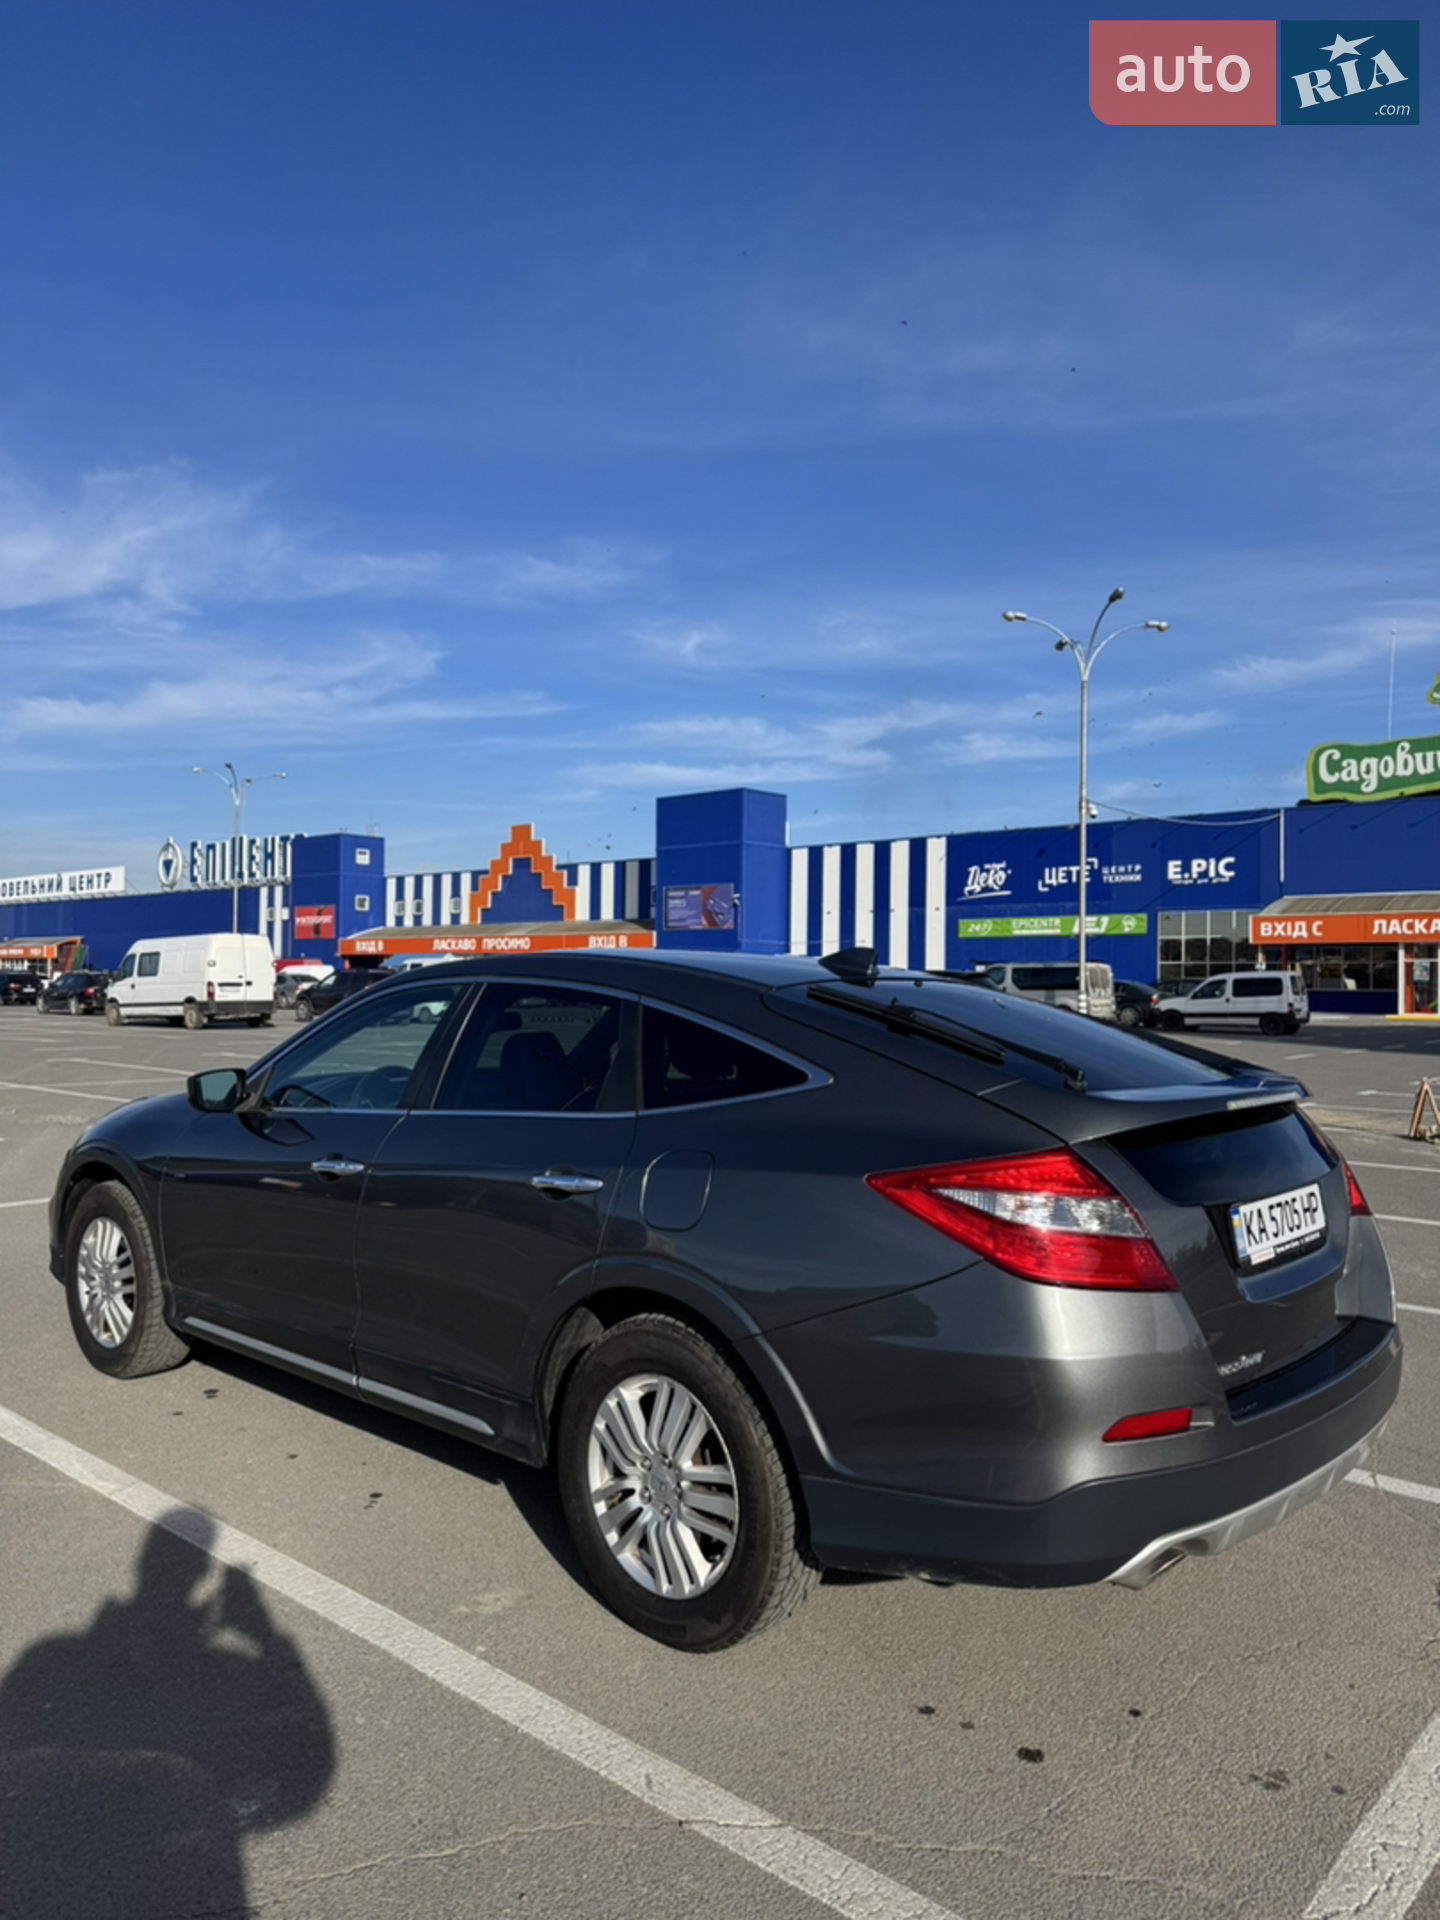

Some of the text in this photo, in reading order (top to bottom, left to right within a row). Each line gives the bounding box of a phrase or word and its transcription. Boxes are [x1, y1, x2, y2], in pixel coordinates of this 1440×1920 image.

[1102, 864, 1142, 874] ЦЕНТР
[1167, 856, 1236, 880] E.PIC
[69, 870, 112, 893] ЦЕНТР
[1259, 921, 1308, 939] ВХІД
[432, 936, 531, 951] ЛАСКАВО ПРОСИМО
[588, 935, 616, 948] ВХІД
[1242, 1208, 1270, 1247] KA
[1268, 1197, 1302, 1238] 5705
[1300, 1191, 1319, 1227] HP
